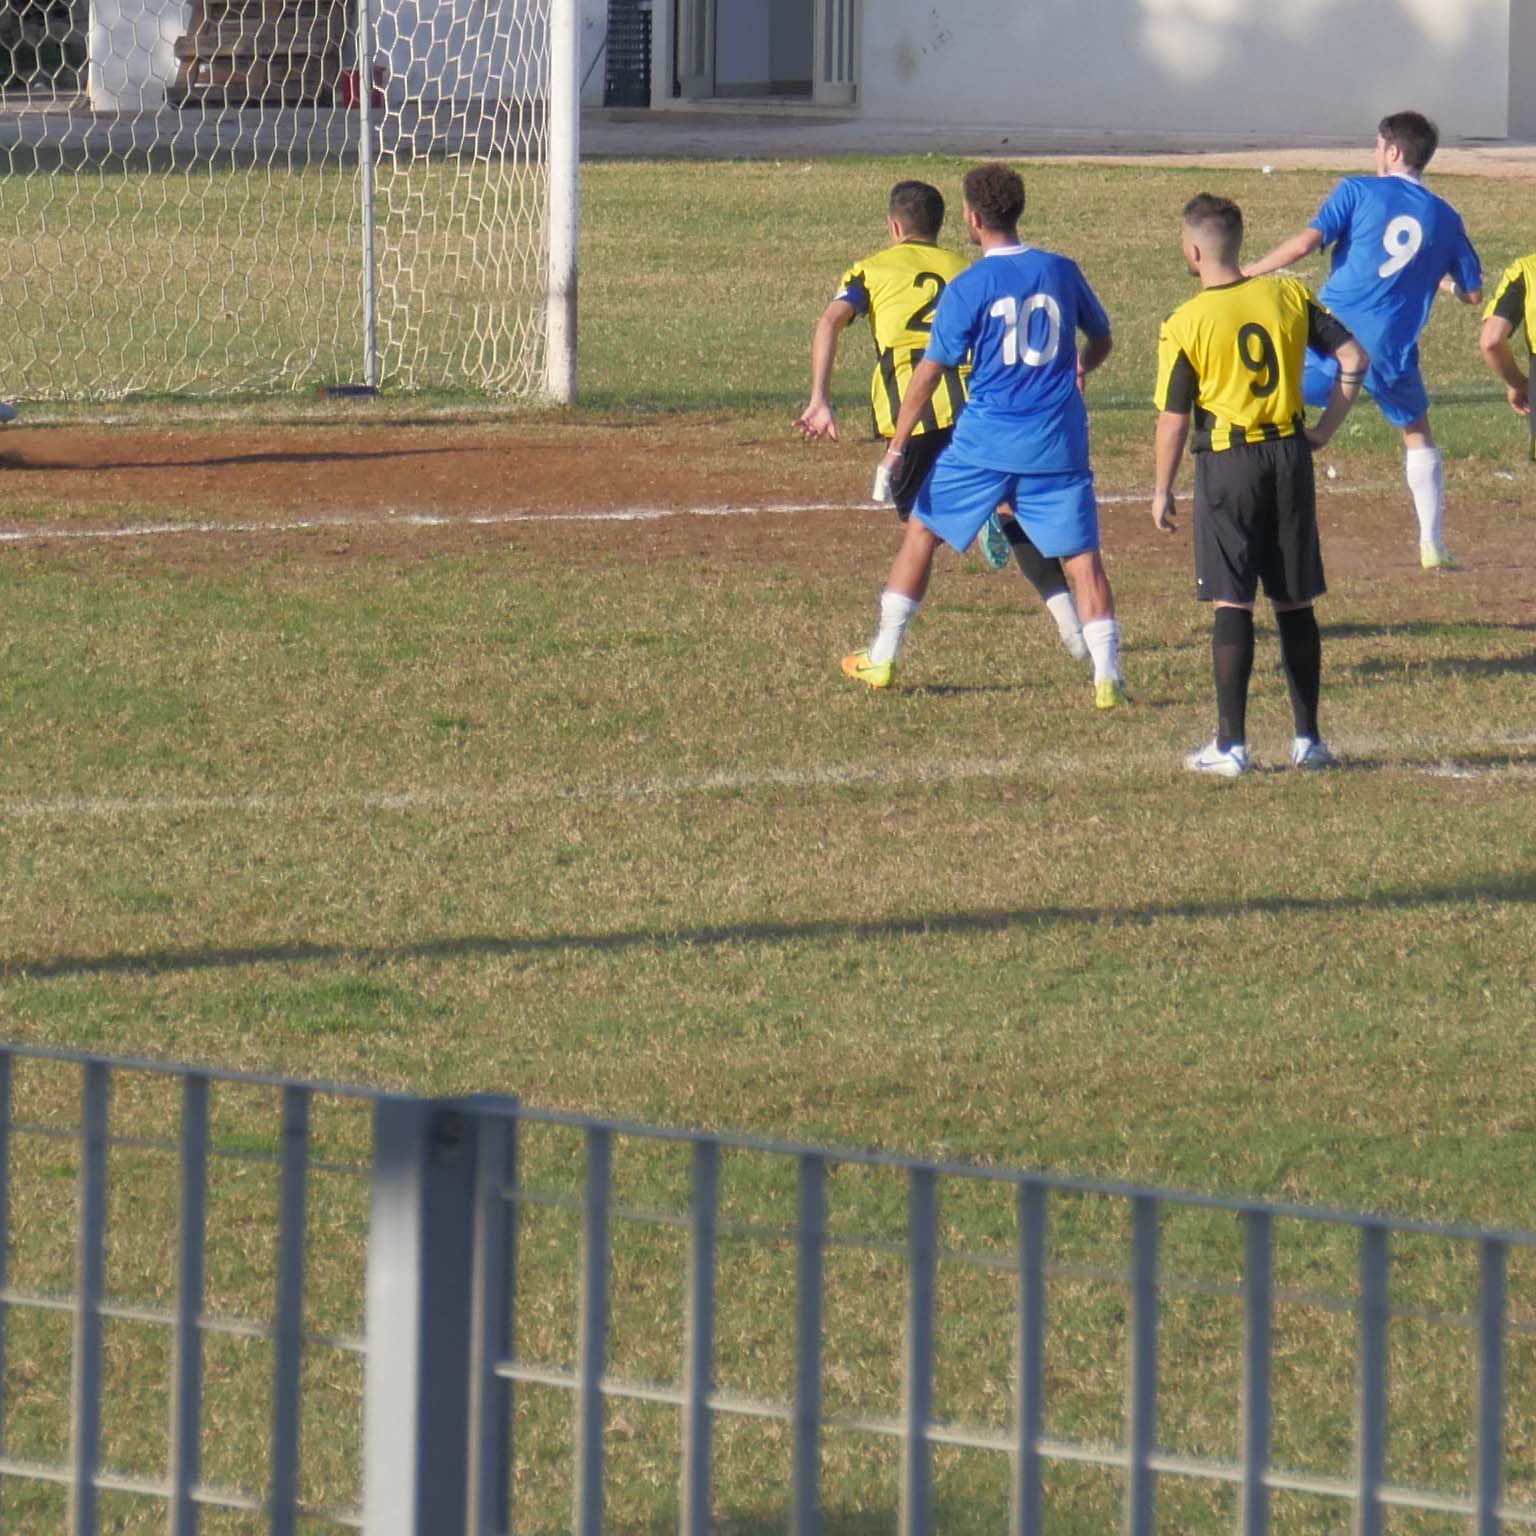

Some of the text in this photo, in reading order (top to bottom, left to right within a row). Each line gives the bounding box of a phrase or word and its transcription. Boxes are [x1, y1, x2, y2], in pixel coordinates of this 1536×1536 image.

[1379, 215, 1423, 279] 9
[906, 272, 947, 333] 2
[990, 295, 1061, 366] 10
[1238, 322, 1280, 398] 9
